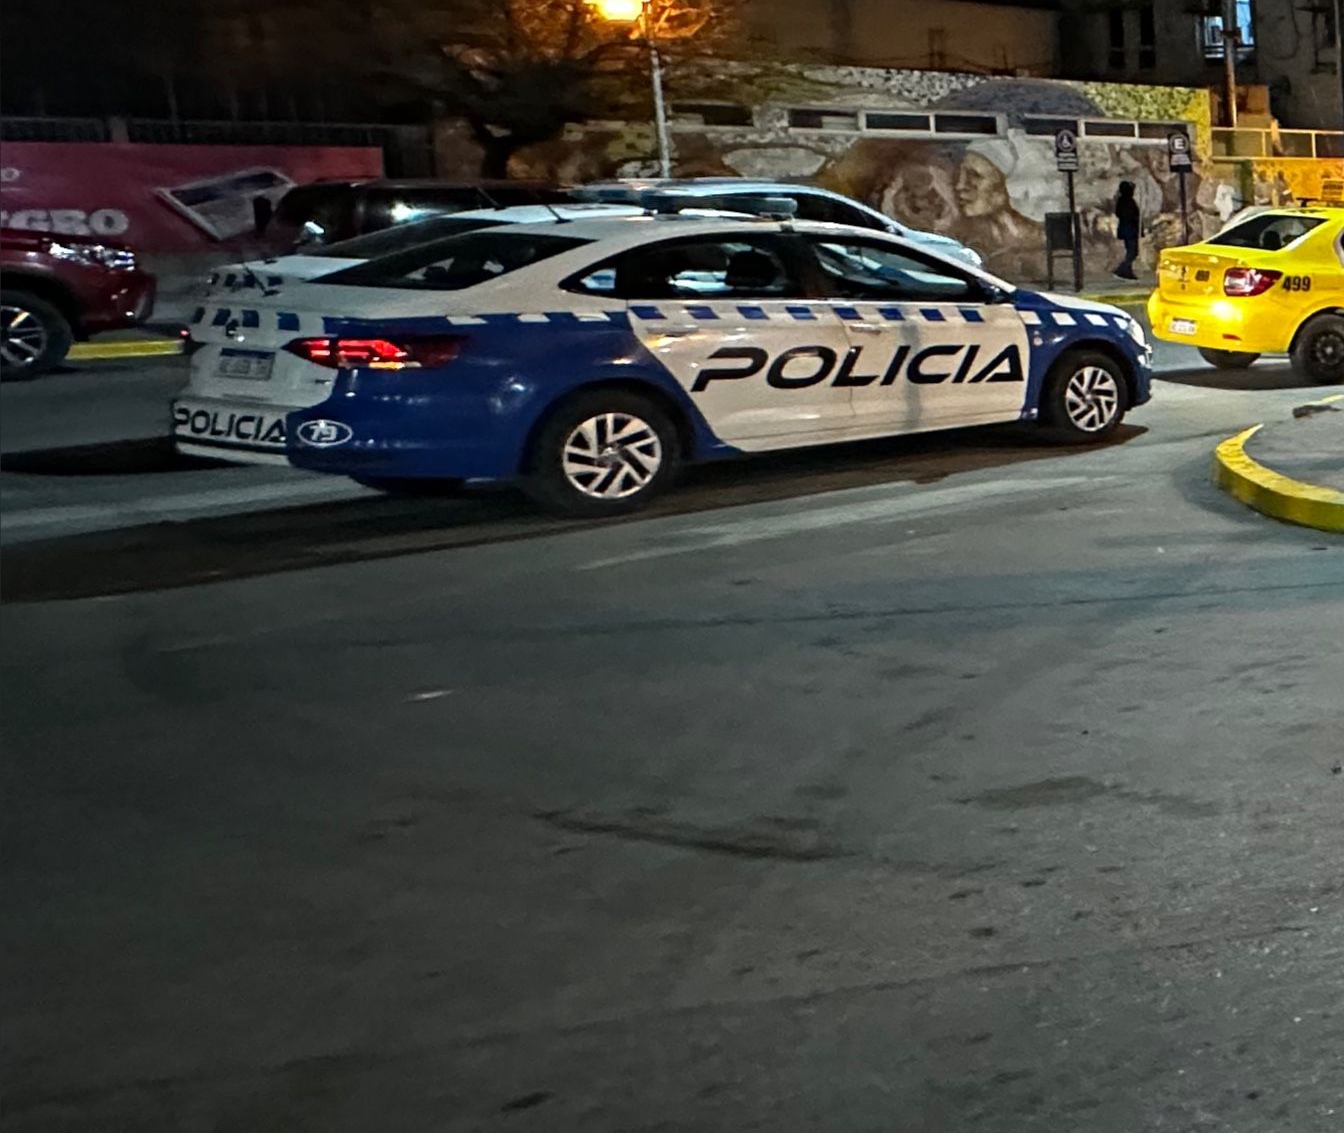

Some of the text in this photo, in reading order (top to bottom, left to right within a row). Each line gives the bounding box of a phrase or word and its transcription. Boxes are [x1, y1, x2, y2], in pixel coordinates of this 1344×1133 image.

[1174, 138, 1184, 149] E
[0, 208, 129, 236] GRO
[1282, 276, 1311, 292] 499
[690, 344, 1024, 392] POLICIA
[174, 407, 287, 443] POLICIA
